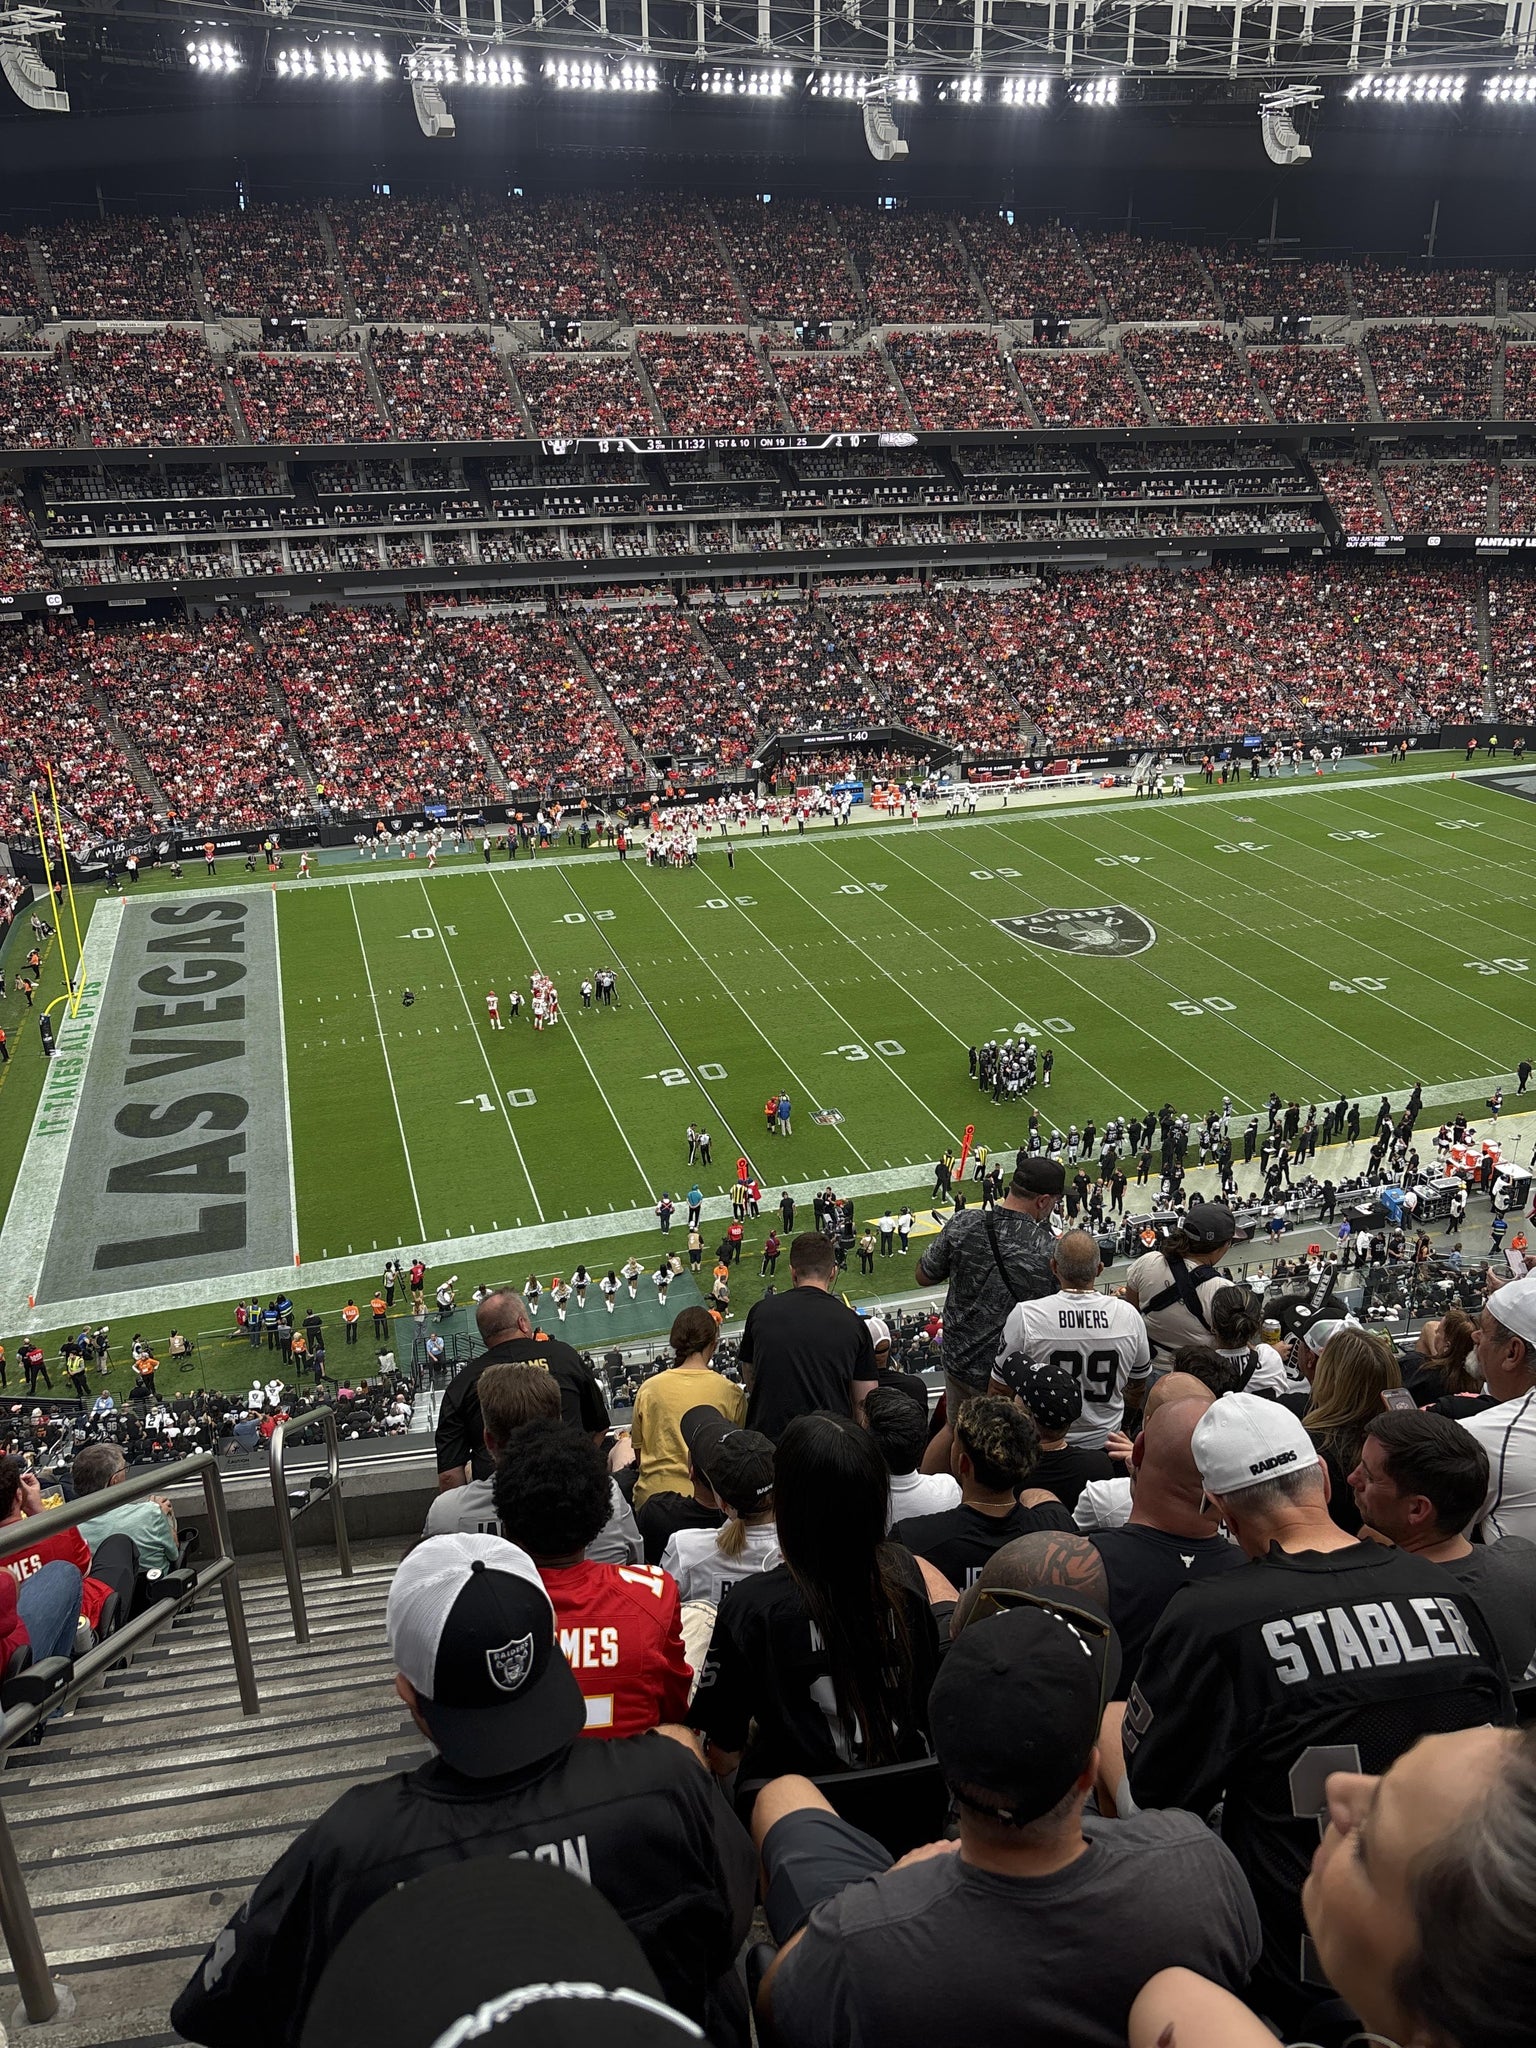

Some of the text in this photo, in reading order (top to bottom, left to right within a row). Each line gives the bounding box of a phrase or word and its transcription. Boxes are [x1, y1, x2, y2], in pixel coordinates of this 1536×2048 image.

[598, 441, 609, 453] 13
[647, 439, 655, 450] 3
[678, 439, 706, 449] 11:32
[714, 440, 731, 449] 1ST
[739, 439, 750, 448] 10
[760, 438, 785, 447] ON 19
[796, 437, 807, 446] 25
[849, 435, 860, 447] 10
[1428, 537, 1440, 545] CC
[1474, 537, 1525, 547] FANTASY
[0, 596, 15, 604] WO
[47, 596, 61, 604] CC
[848, 731, 868, 741] 1:40
[112, 842, 126, 854] LOS
[969, 867, 1024, 881] 50
[1011, 908, 1116, 926] RAIDERS
[1463, 956, 1532, 977] 30
[1327, 976, 1388, 995] 40
[1167, 995, 1238, 1017] 50
[1012, 1017, 1076, 1037] 40
[837, 1039, 908, 1062] 30
[36, 981, 102, 1137] IT TAKES ALL OF US
[658, 1062, 729, 1088] 20
[92, 899, 250, 1272] LAS VEGAS
[473, 1087, 538, 1113] 10
[1360, 1178, 1370, 1188] 15
[1310, 1245, 1320, 1255] 40
[1058, 1310, 1109, 1329] BOWERS
[1249, 1449, 1298, 1477] RAIDERS
[554, 1626, 620, 1669] MES
[1261, 1597, 1480, 1686] STABLER
[493, 1640, 529, 1661] RAIDERS
